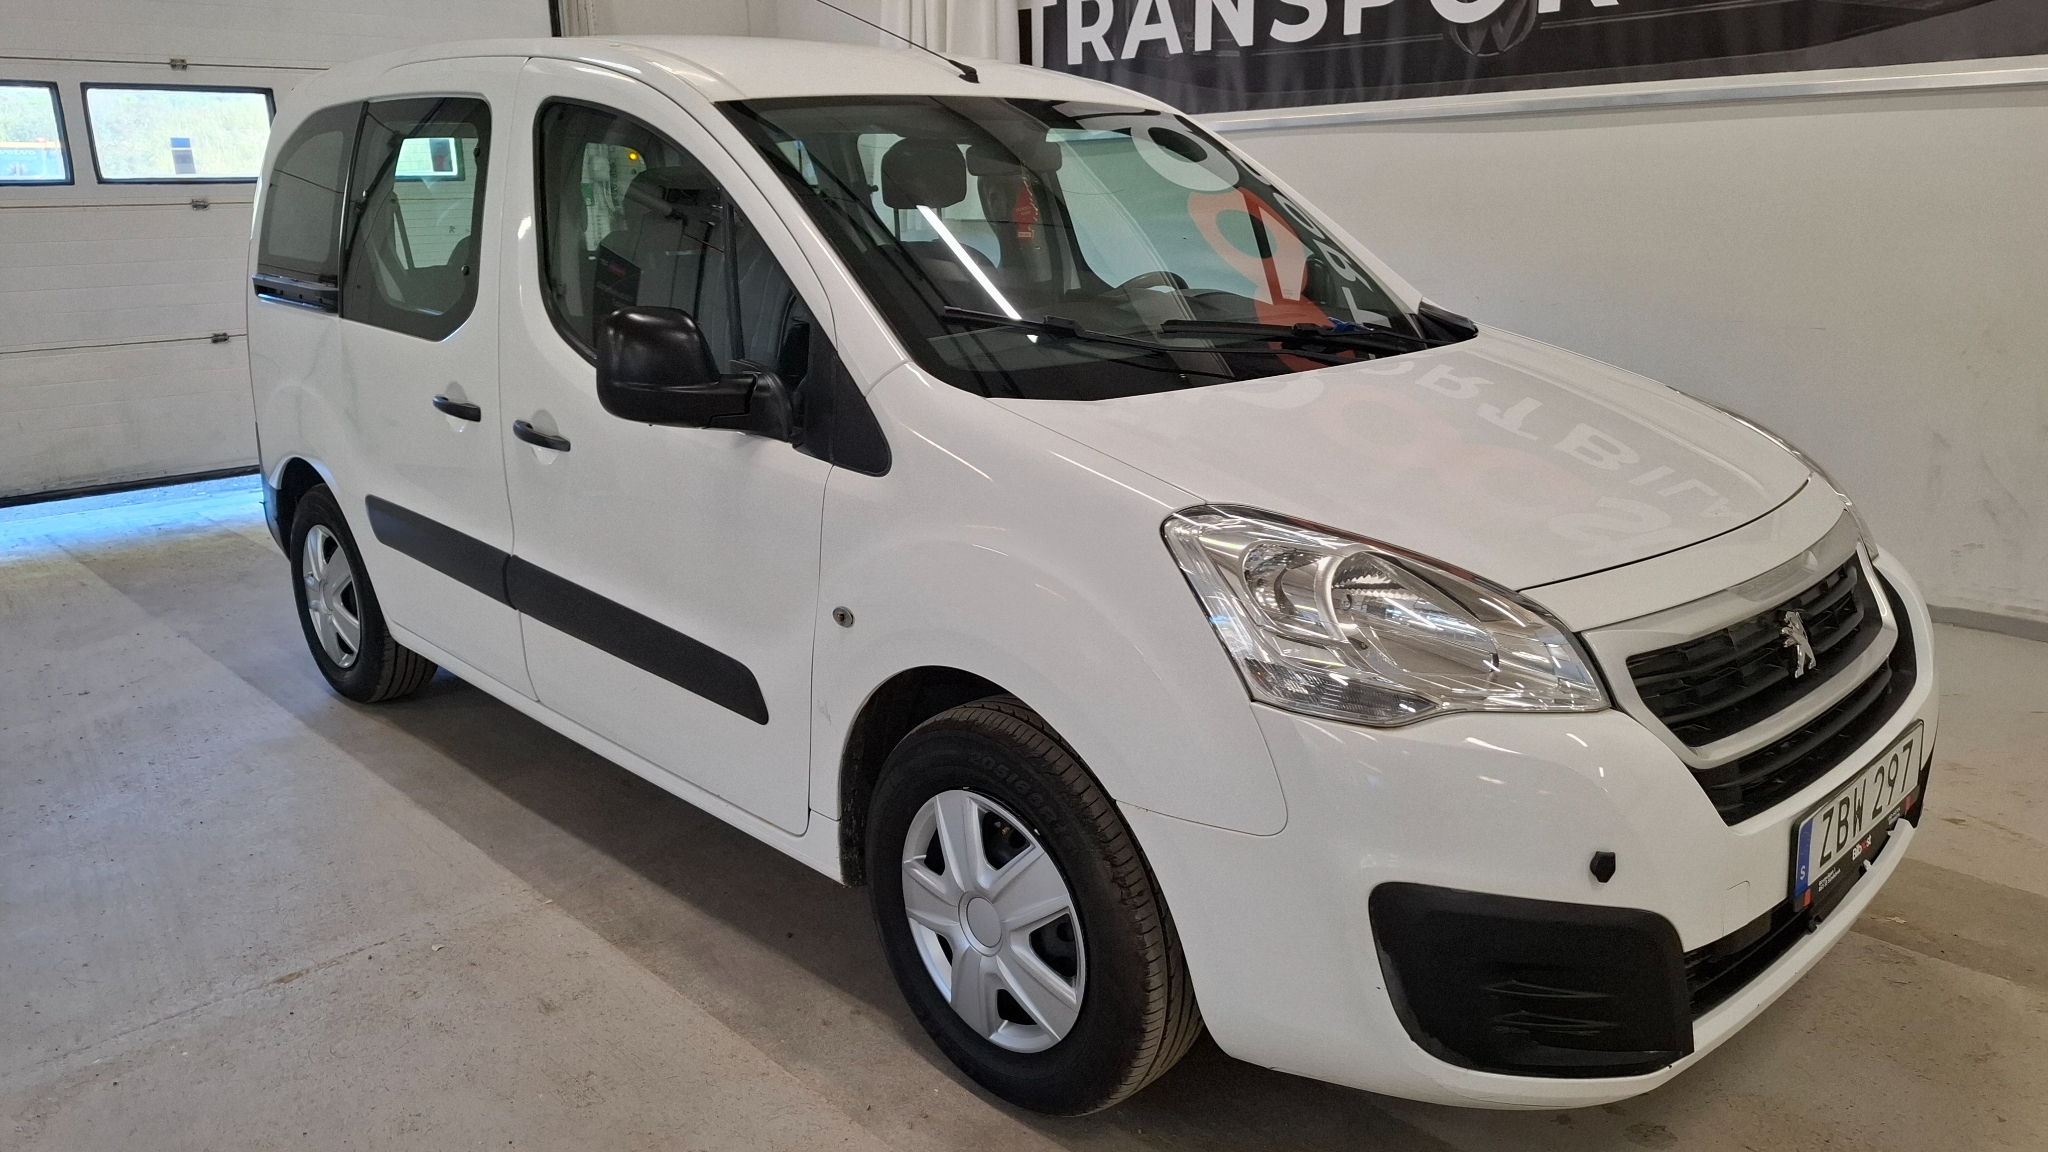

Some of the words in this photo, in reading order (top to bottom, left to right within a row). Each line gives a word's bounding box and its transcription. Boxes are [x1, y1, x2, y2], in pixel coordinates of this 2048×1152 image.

[1018, 0, 1620, 67] TRANS
[1819, 778, 1868, 868] ZBW
[1871, 738, 1914, 821] 297
[1800, 865, 1806, 880] S
